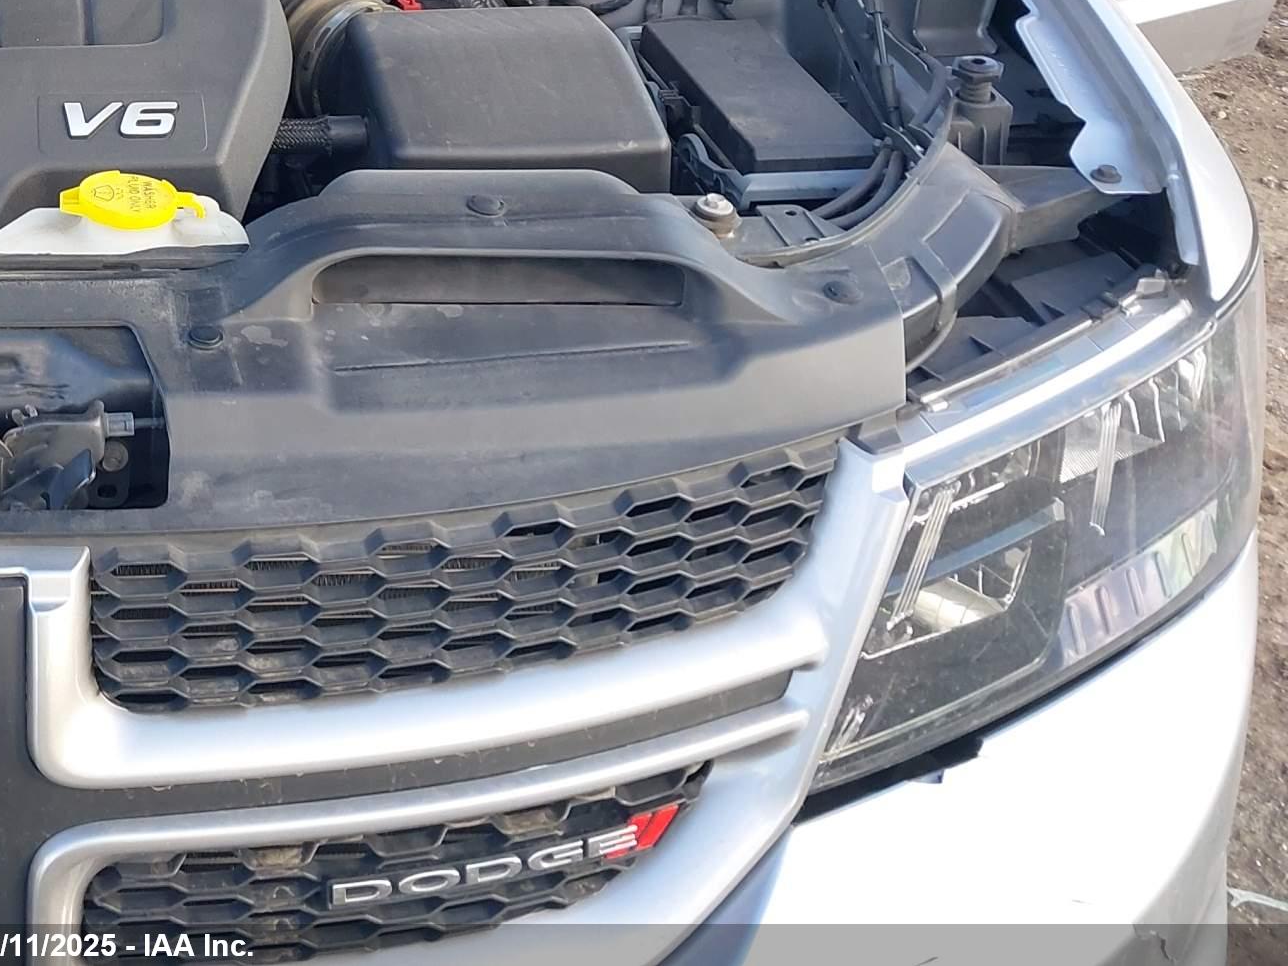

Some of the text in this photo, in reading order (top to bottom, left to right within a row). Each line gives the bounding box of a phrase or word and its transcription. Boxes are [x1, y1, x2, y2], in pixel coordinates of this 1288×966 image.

[63, 101, 179, 139] V6
[142, 181, 157, 210] WASHER
[331, 824, 639, 907] DODGE
